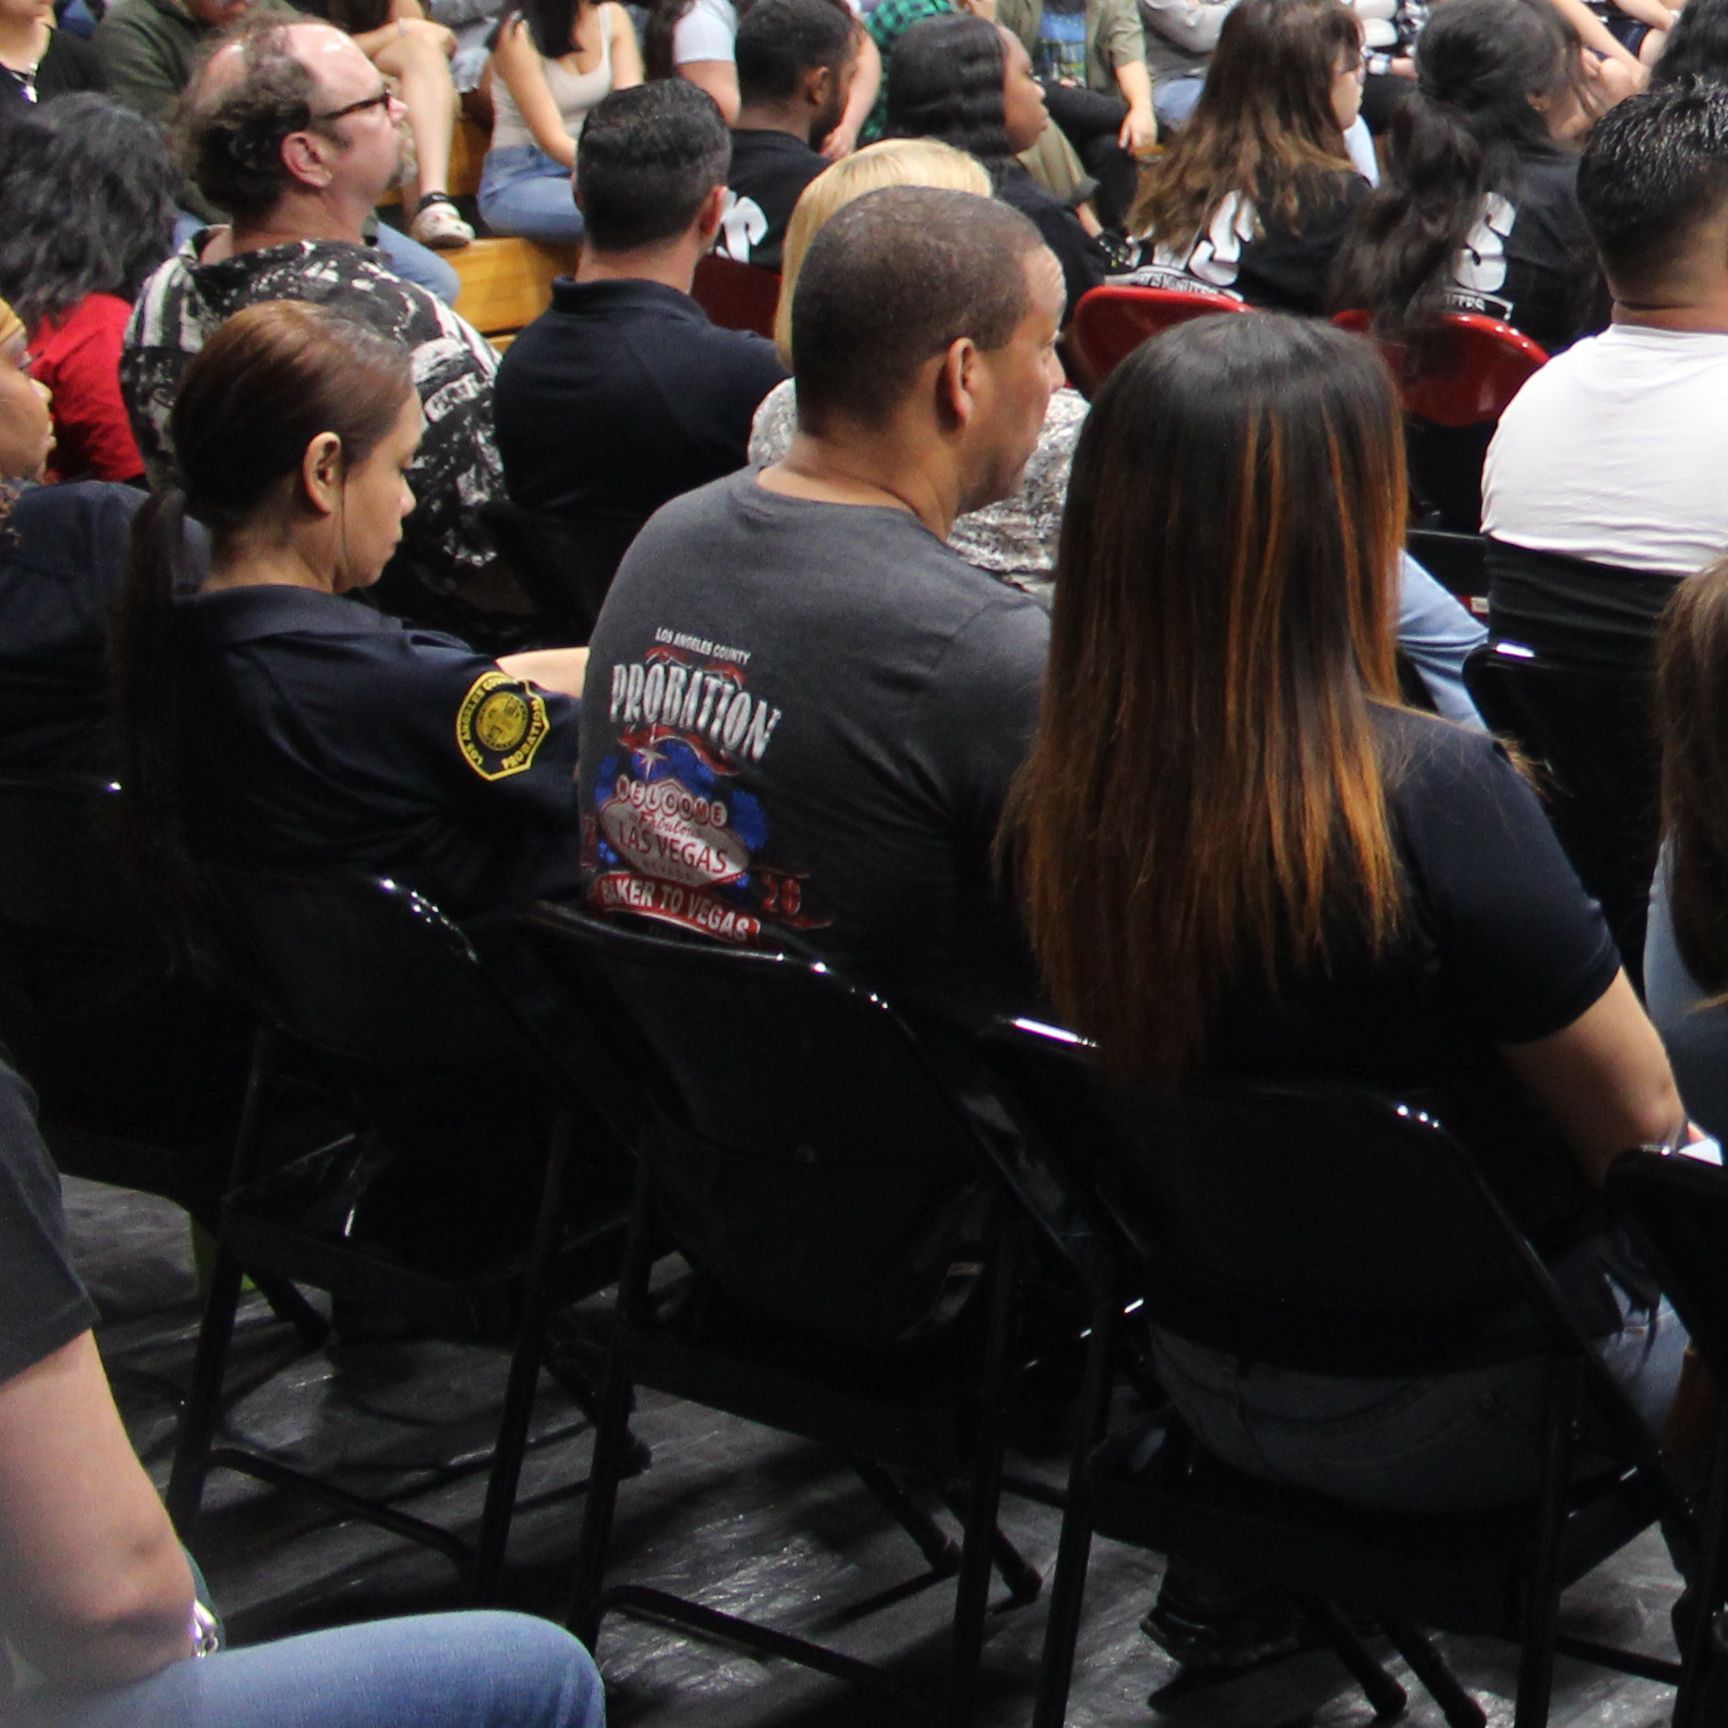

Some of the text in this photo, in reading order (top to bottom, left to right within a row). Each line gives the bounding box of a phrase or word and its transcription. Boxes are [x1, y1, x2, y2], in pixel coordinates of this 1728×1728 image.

[655, 626, 751, 665] LOS ANGELES COUNTY
[610, 663, 782, 762] PROBATION
[617, 775, 728, 826] WELCOME
[618, 821, 652, 854] LAS
[657, 834, 729, 873] VEGAS
[658, 881, 684, 911] TO
[687, 888, 750, 942] VEGAS
